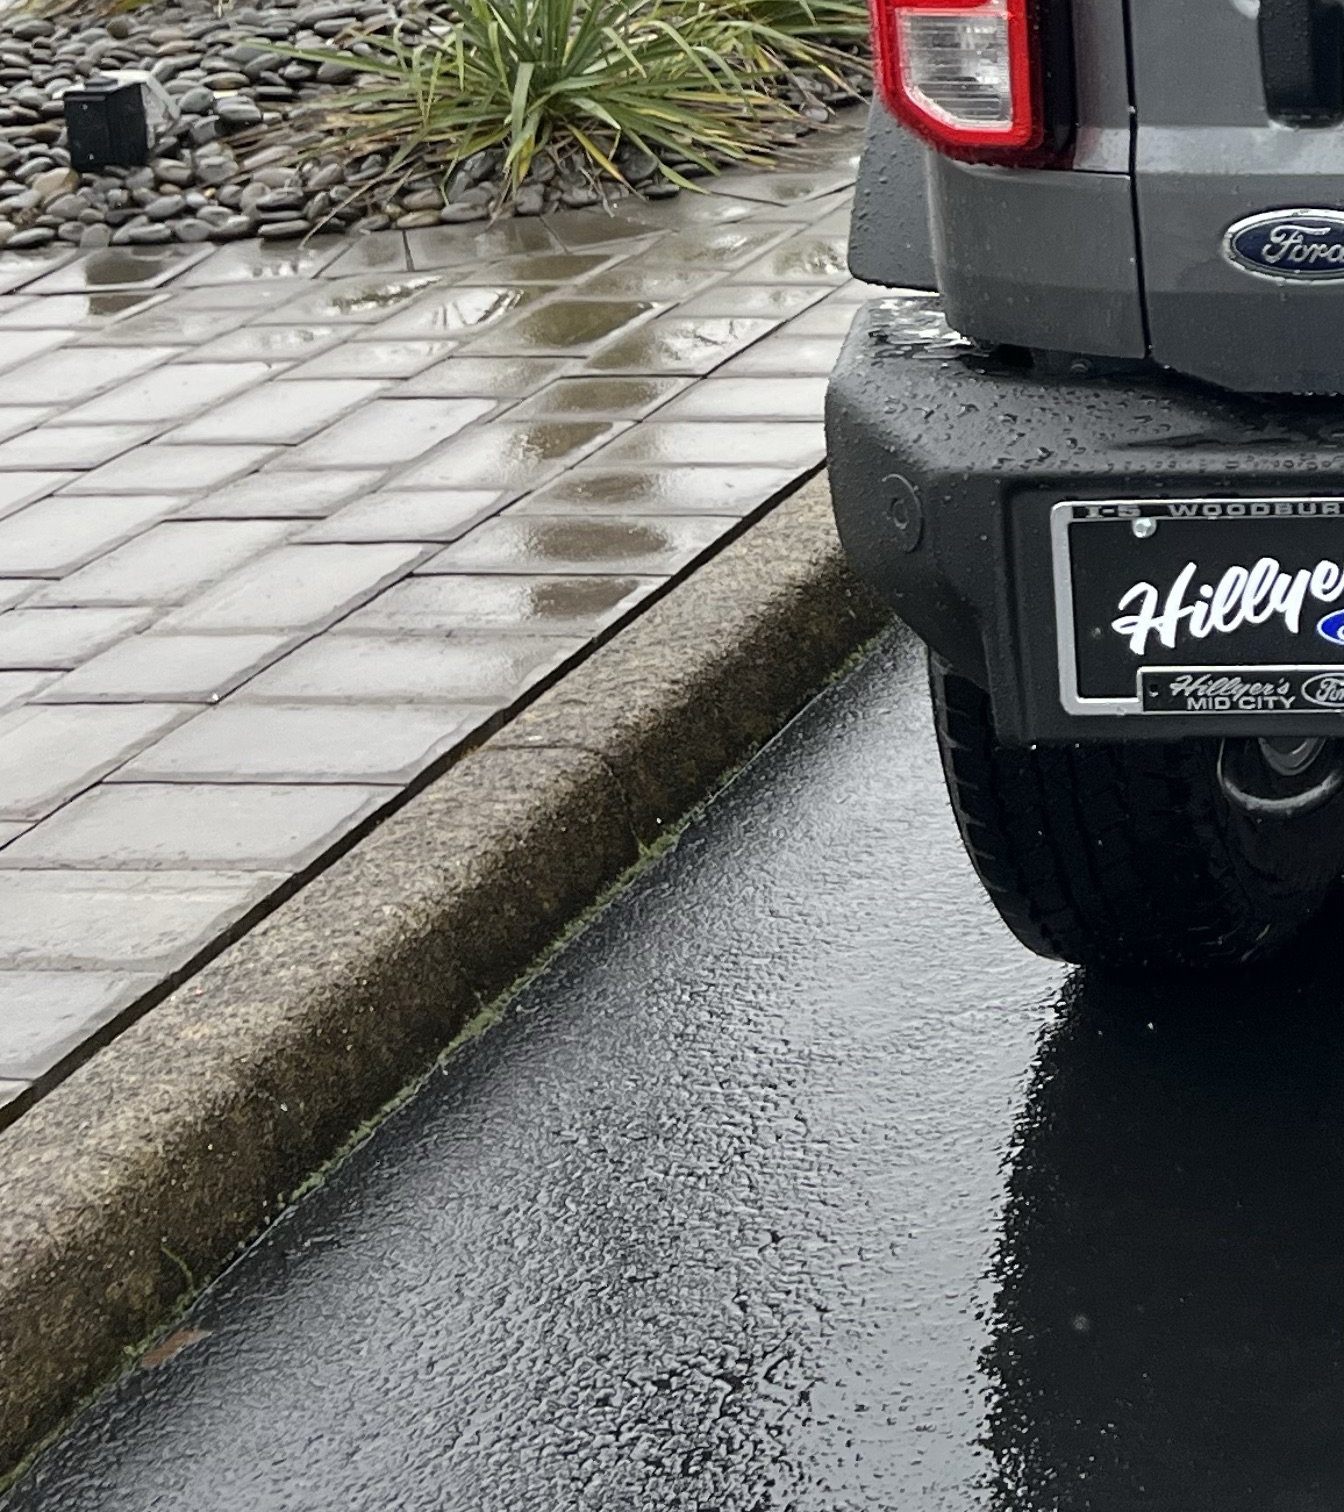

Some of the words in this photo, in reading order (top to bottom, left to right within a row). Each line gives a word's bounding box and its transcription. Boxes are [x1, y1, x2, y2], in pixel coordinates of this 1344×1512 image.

[1085, 504, 1141, 519] I-5
[1169, 674, 1291, 702] Hillyer's
[1186, 696, 1233, 710] MID
[1238, 695, 1297, 710] CITY
